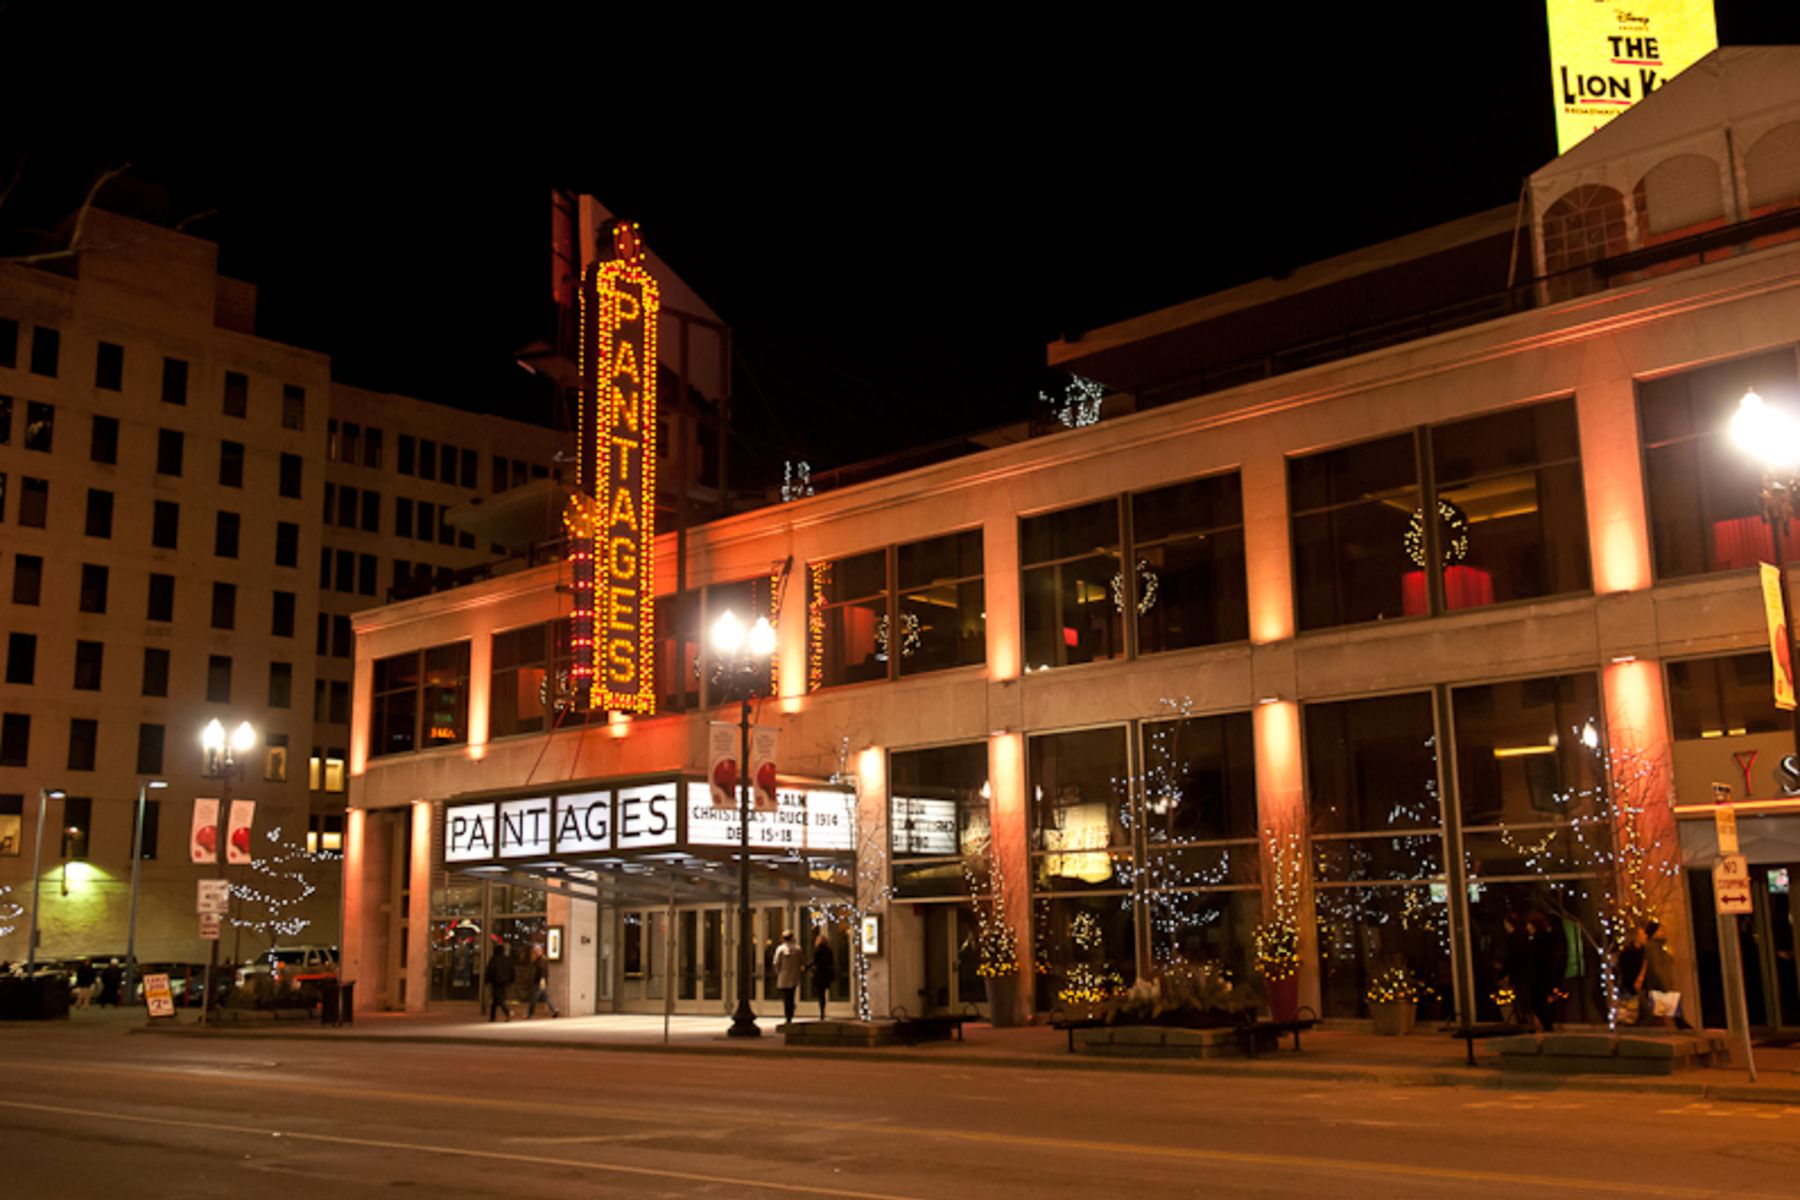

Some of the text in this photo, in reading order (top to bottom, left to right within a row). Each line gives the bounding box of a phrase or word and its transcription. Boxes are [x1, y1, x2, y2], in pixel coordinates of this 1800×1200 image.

[1607, 36, 1660, 59] THE
[608, 290, 640, 684] PANTAGES
[451, 794, 668, 853] PANTAGES
[773, 809, 809, 826] TRUCE
[815, 813, 838, 826] 1914
